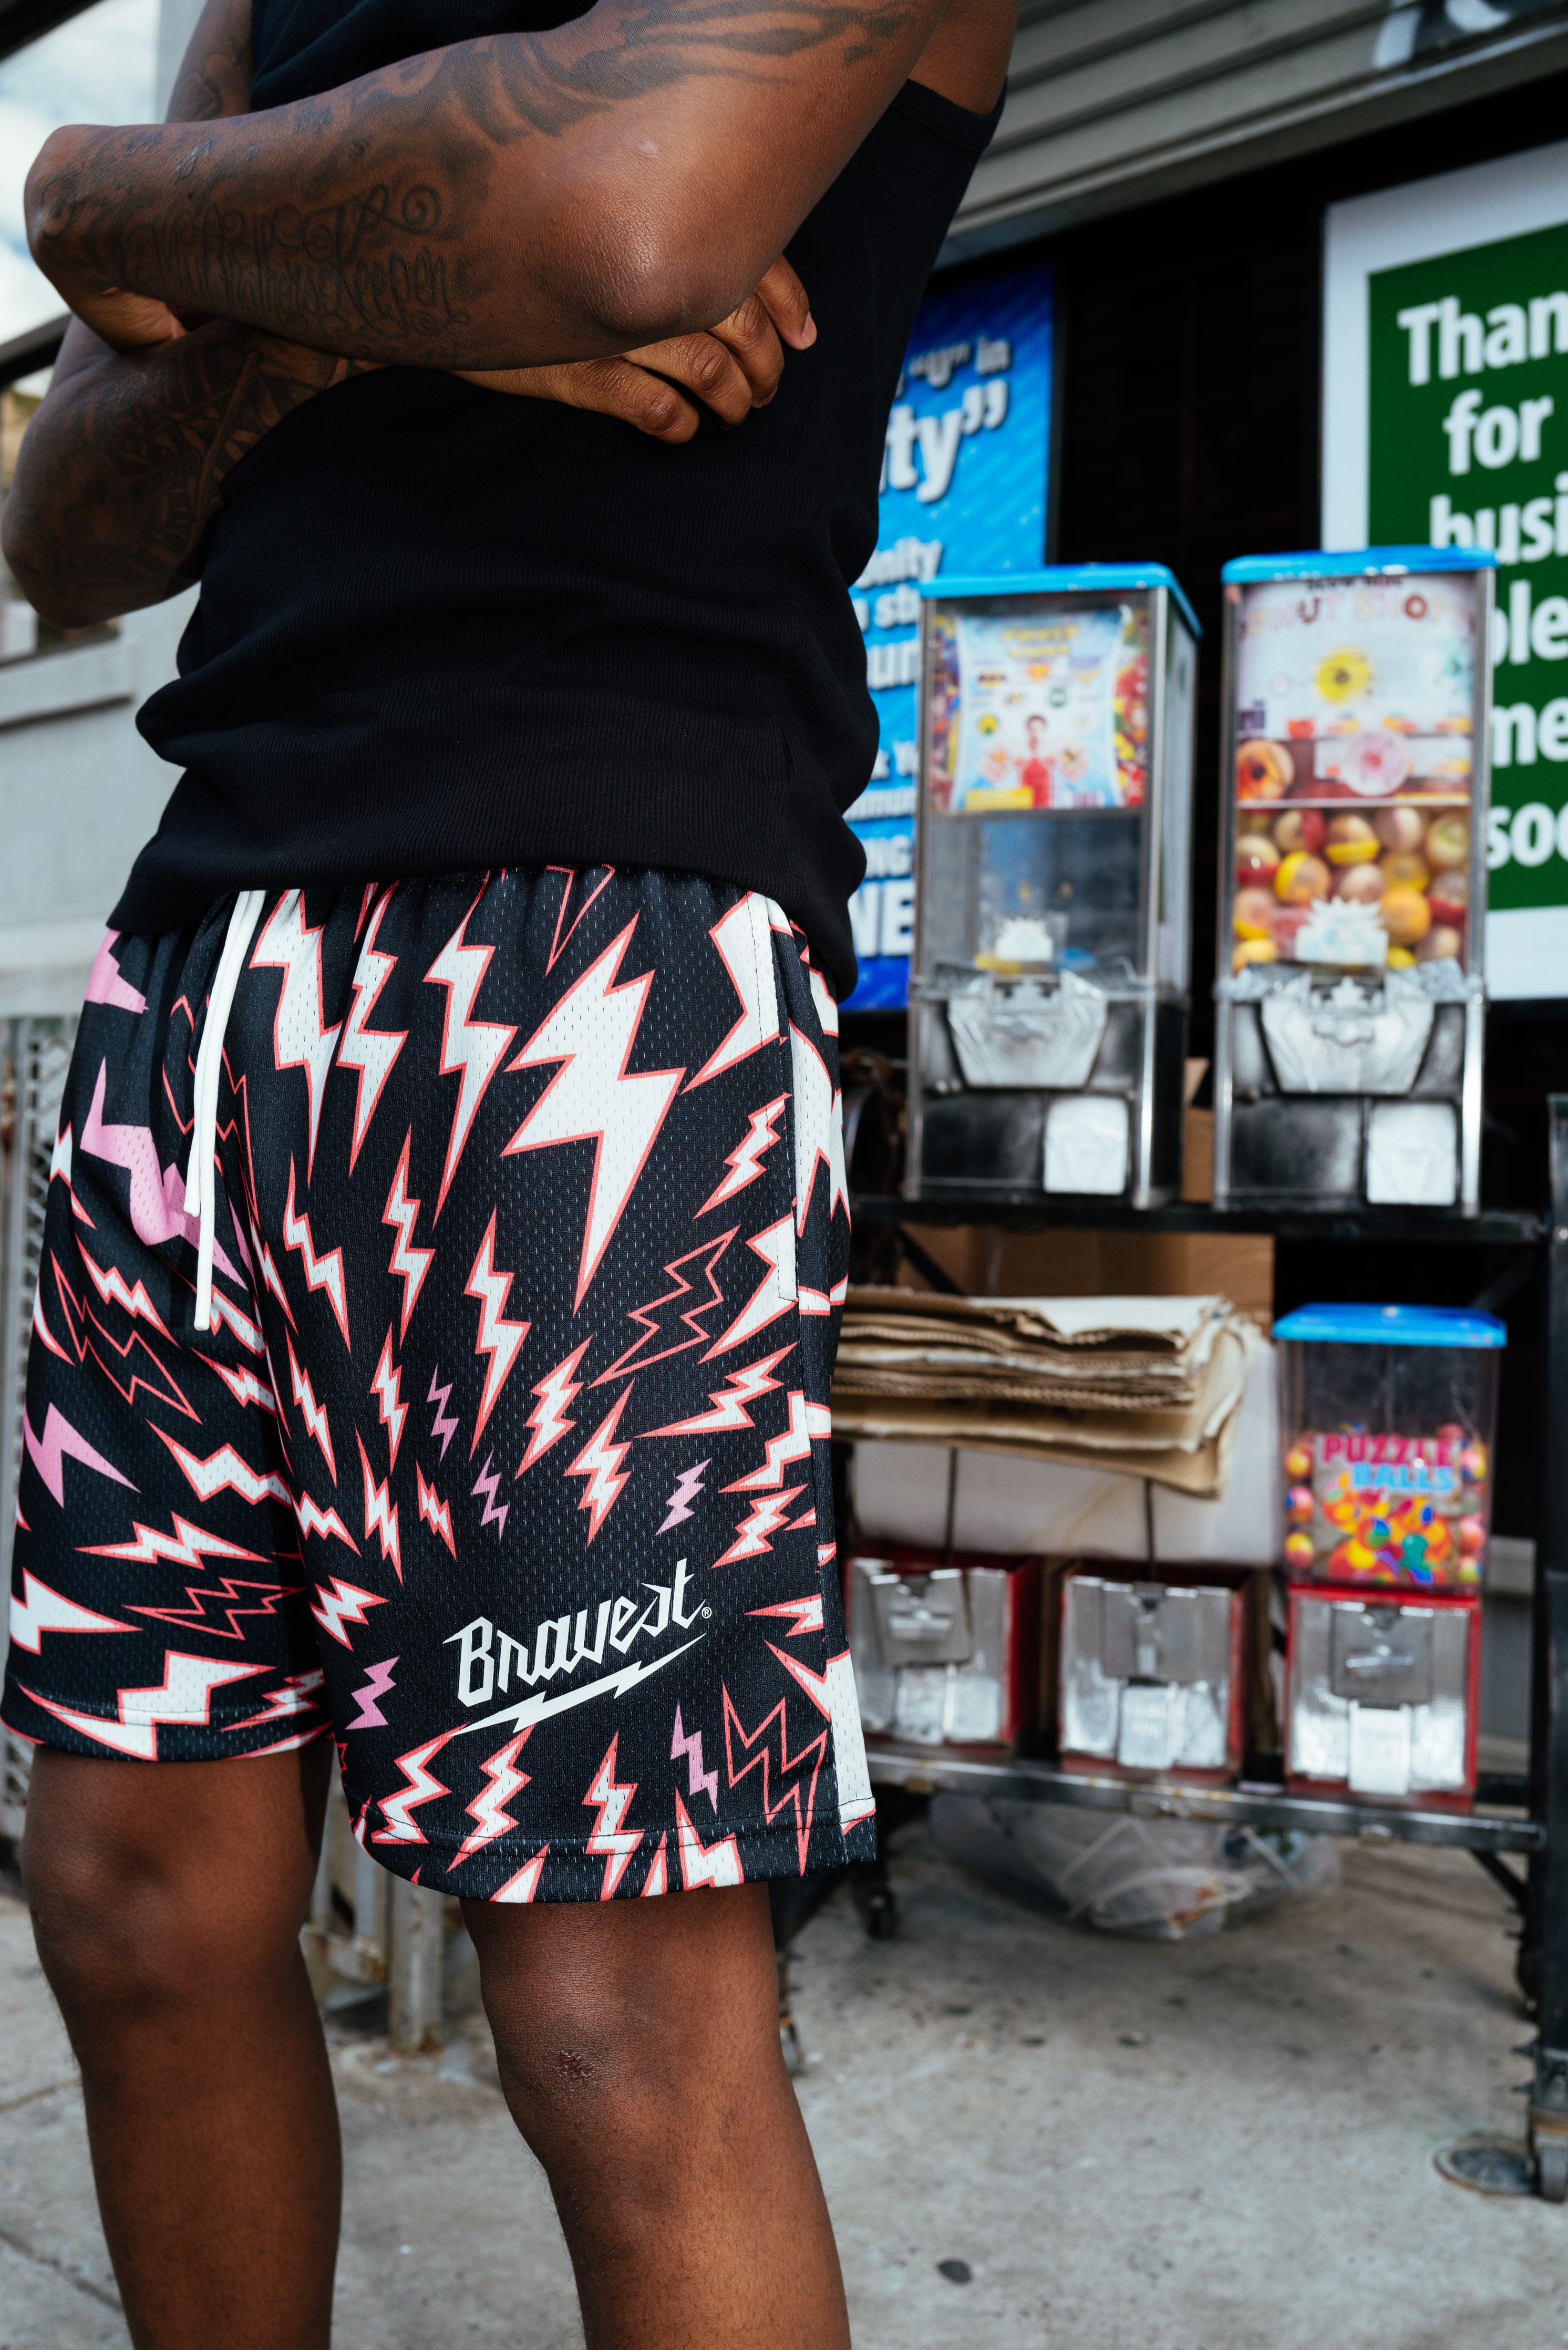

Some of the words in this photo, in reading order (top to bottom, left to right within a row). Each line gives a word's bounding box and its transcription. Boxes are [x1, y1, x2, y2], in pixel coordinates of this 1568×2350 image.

[1397, 291, 1568, 387] Than
[880, 377, 1008, 503] ty"
[1442, 389, 1554, 476] for
[1322, 1435, 1456, 1467] PUZZLE
[1350, 1461, 1456, 1493] BALLS
